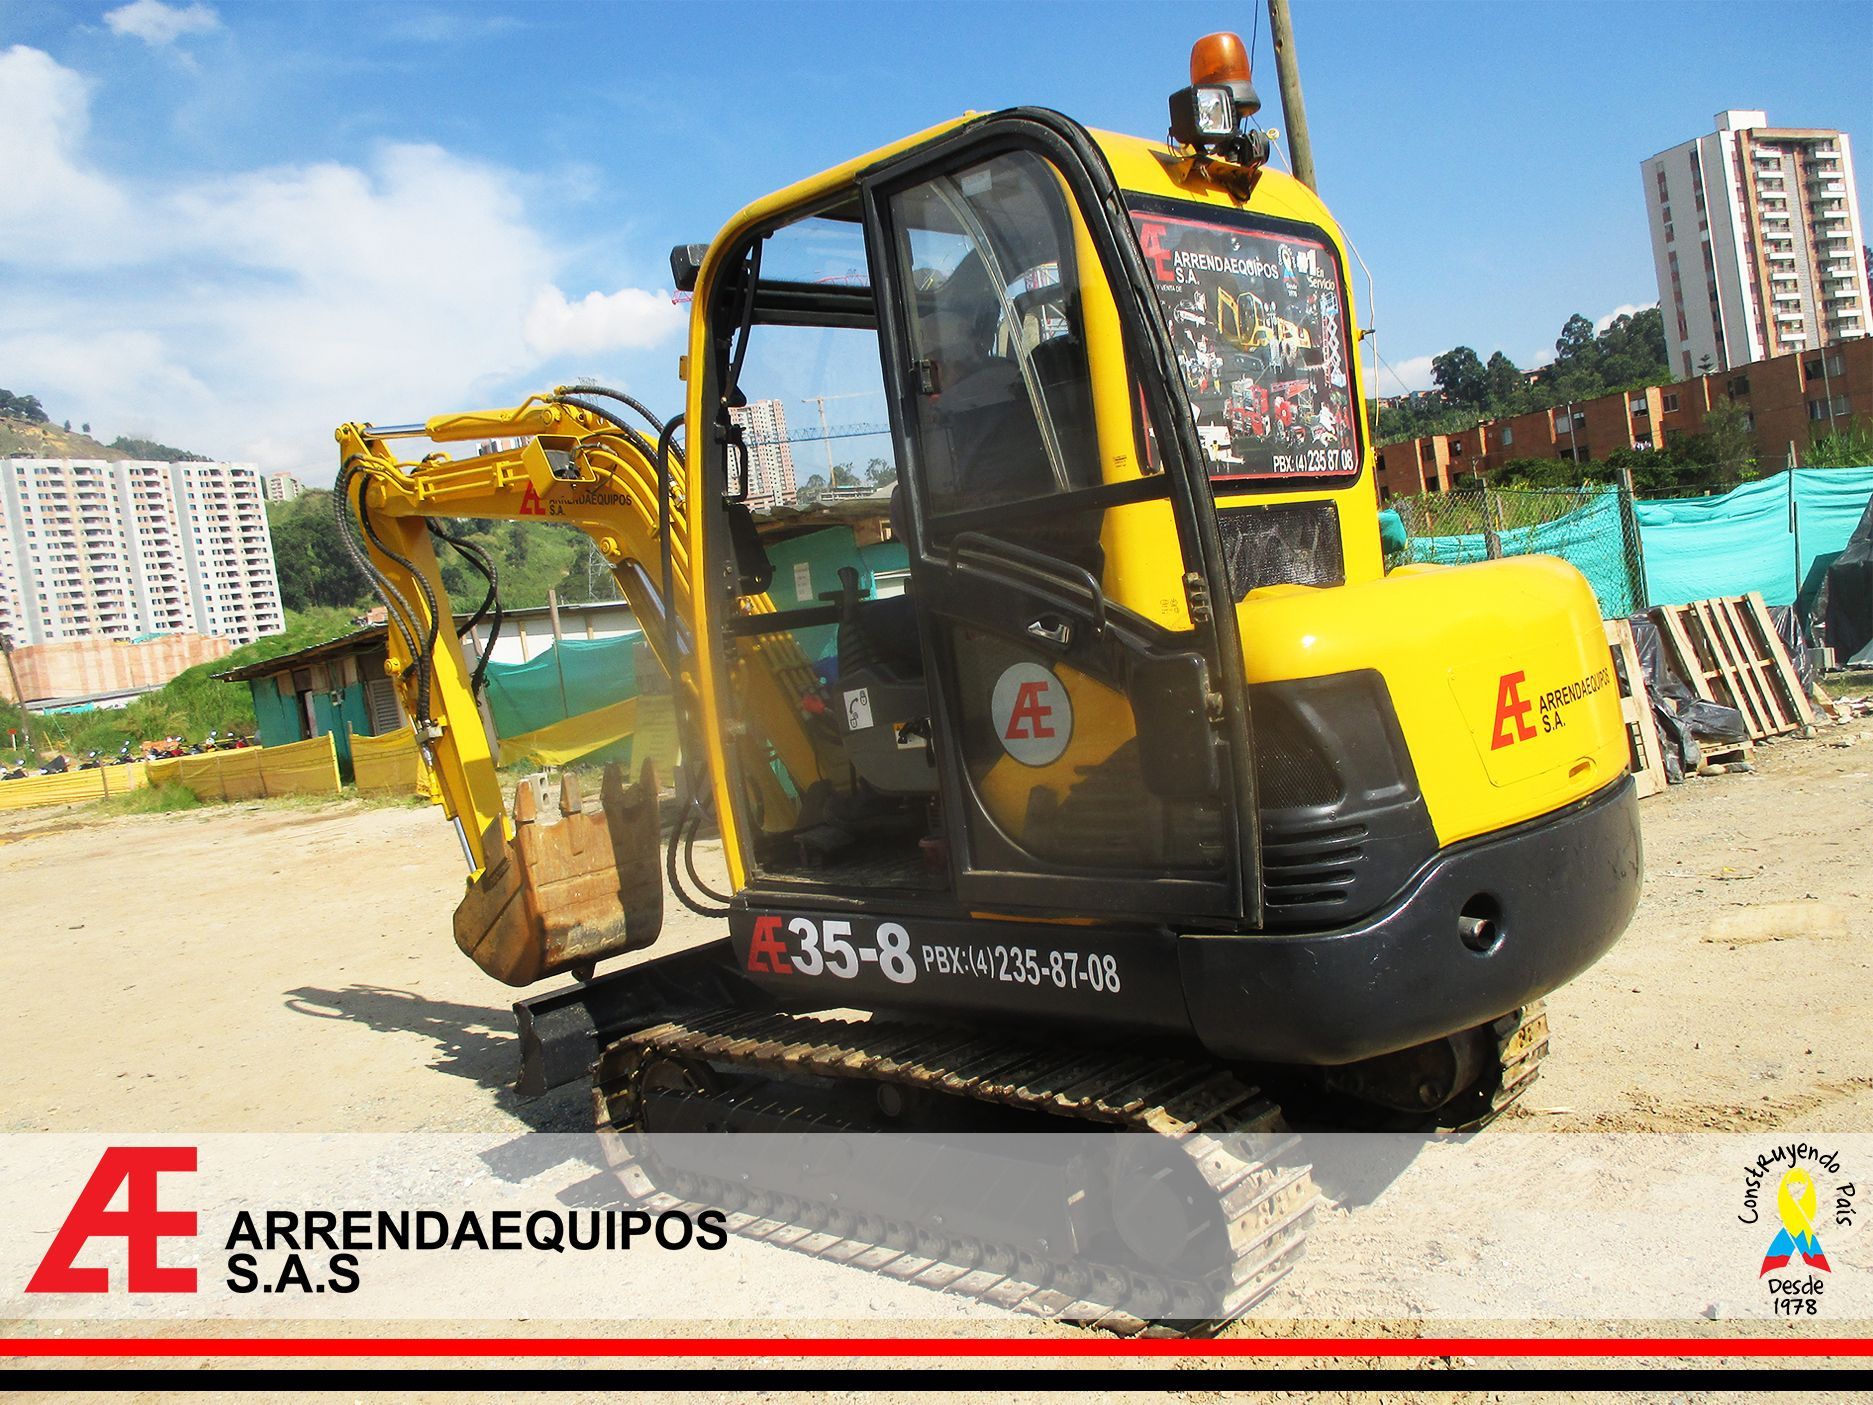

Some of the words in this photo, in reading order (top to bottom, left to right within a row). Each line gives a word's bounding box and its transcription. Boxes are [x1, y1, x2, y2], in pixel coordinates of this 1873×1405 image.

[1174, 250, 1279, 279] ARRENDAEQUIPOS
[1175, 267, 1200, 285] S.A.
[1308, 275, 1335, 291] Servicio
[1542, 711, 1566, 733] S.A.
